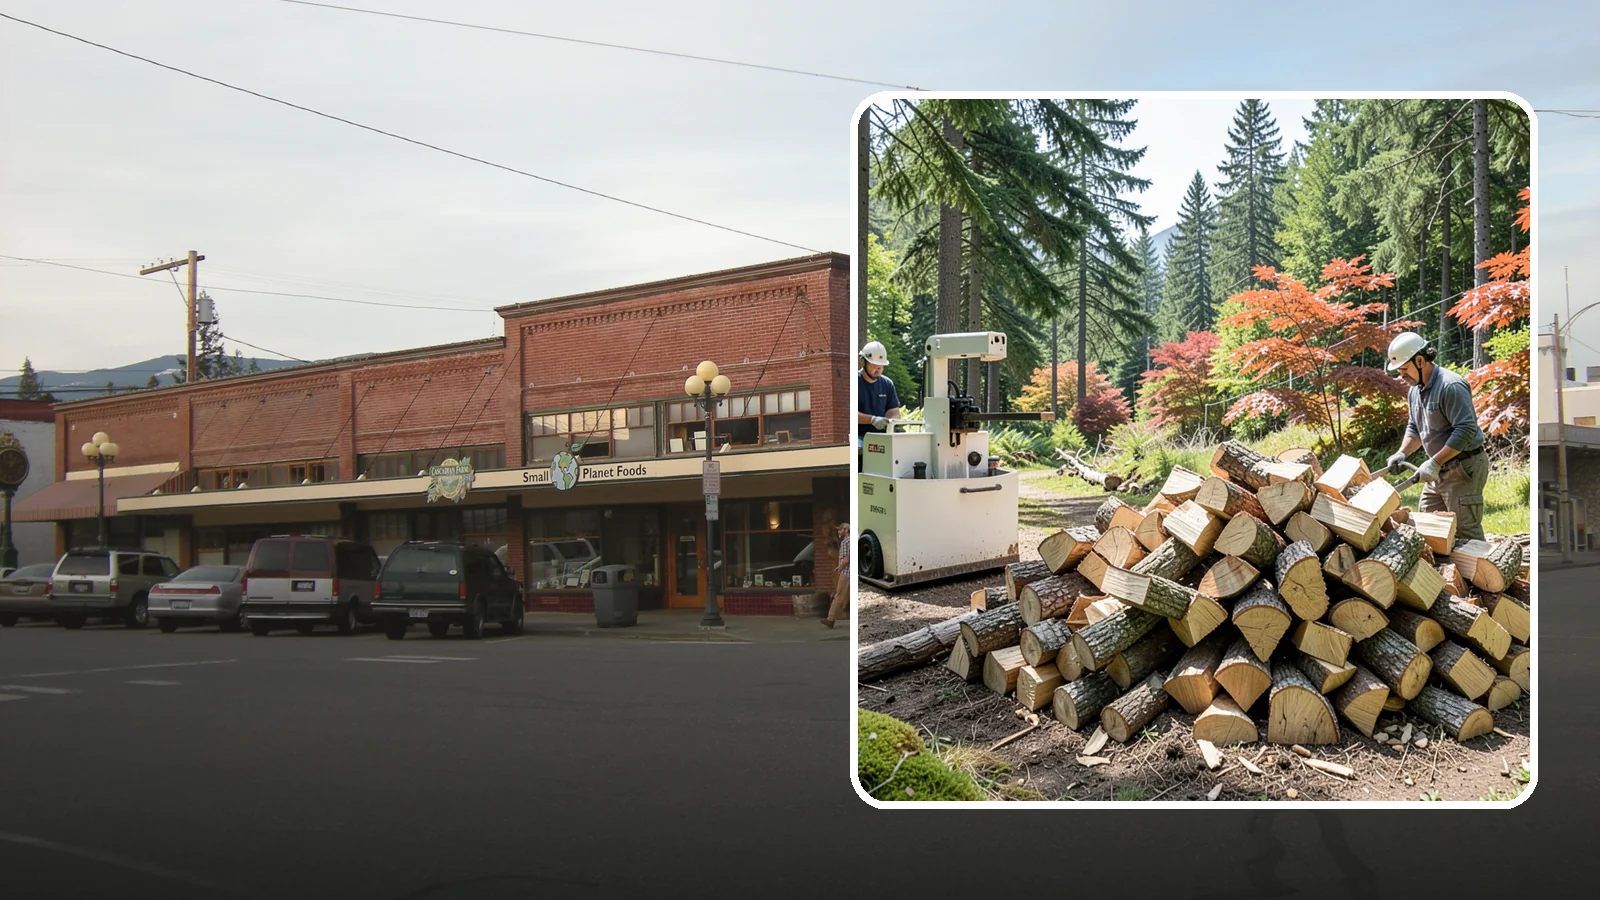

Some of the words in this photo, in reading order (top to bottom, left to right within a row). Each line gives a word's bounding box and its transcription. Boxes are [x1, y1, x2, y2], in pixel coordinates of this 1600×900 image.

[522, 471, 549, 483] Small
[582, 468, 614, 479] Planet
[616, 464, 647, 477] Foods
